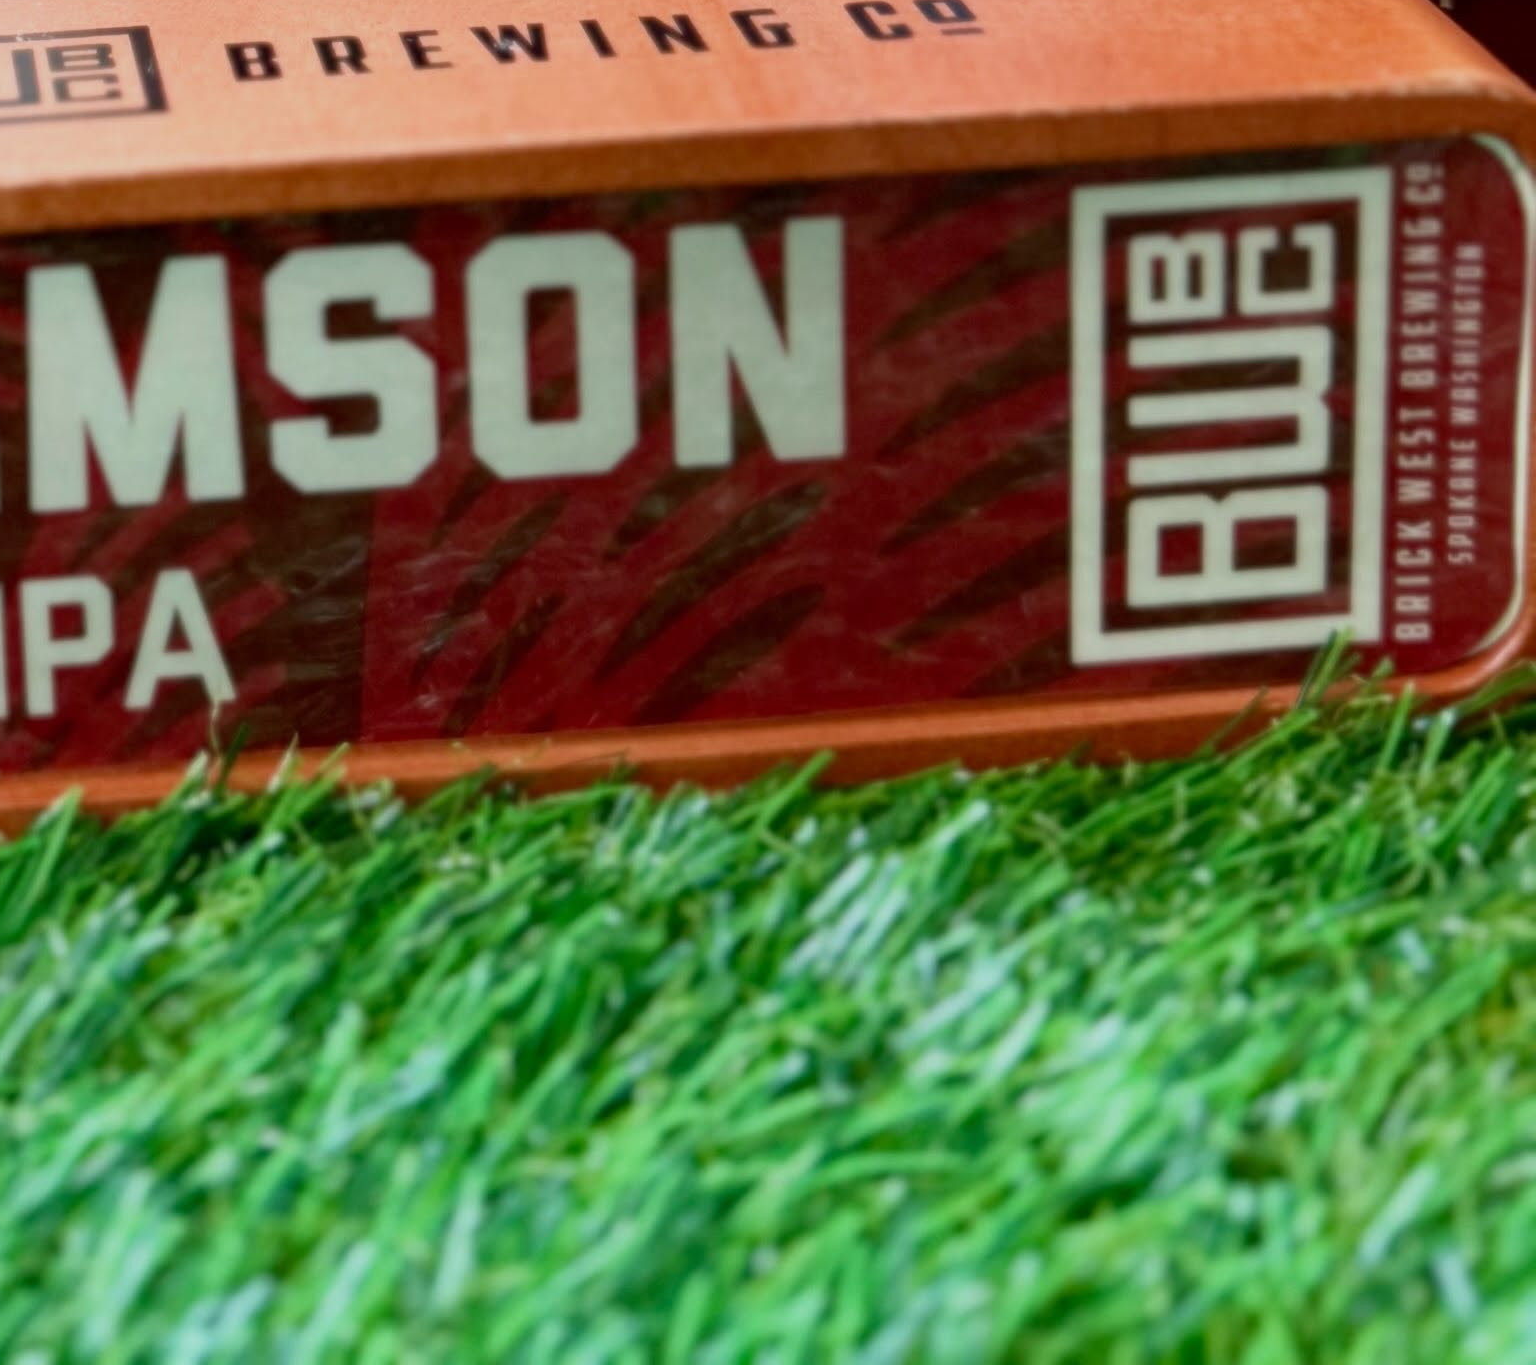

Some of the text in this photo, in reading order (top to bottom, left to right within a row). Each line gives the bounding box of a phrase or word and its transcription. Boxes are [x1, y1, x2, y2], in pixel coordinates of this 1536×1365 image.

[225, 8, 796, 83] BREWING
[1400, 218, 1443, 390] BREWING
[1397, 407, 1436, 503] WEST
[1448, 245, 1484, 564] SPOKANE WASHINGTON
[1394, 521, 1432, 641] BRICK
